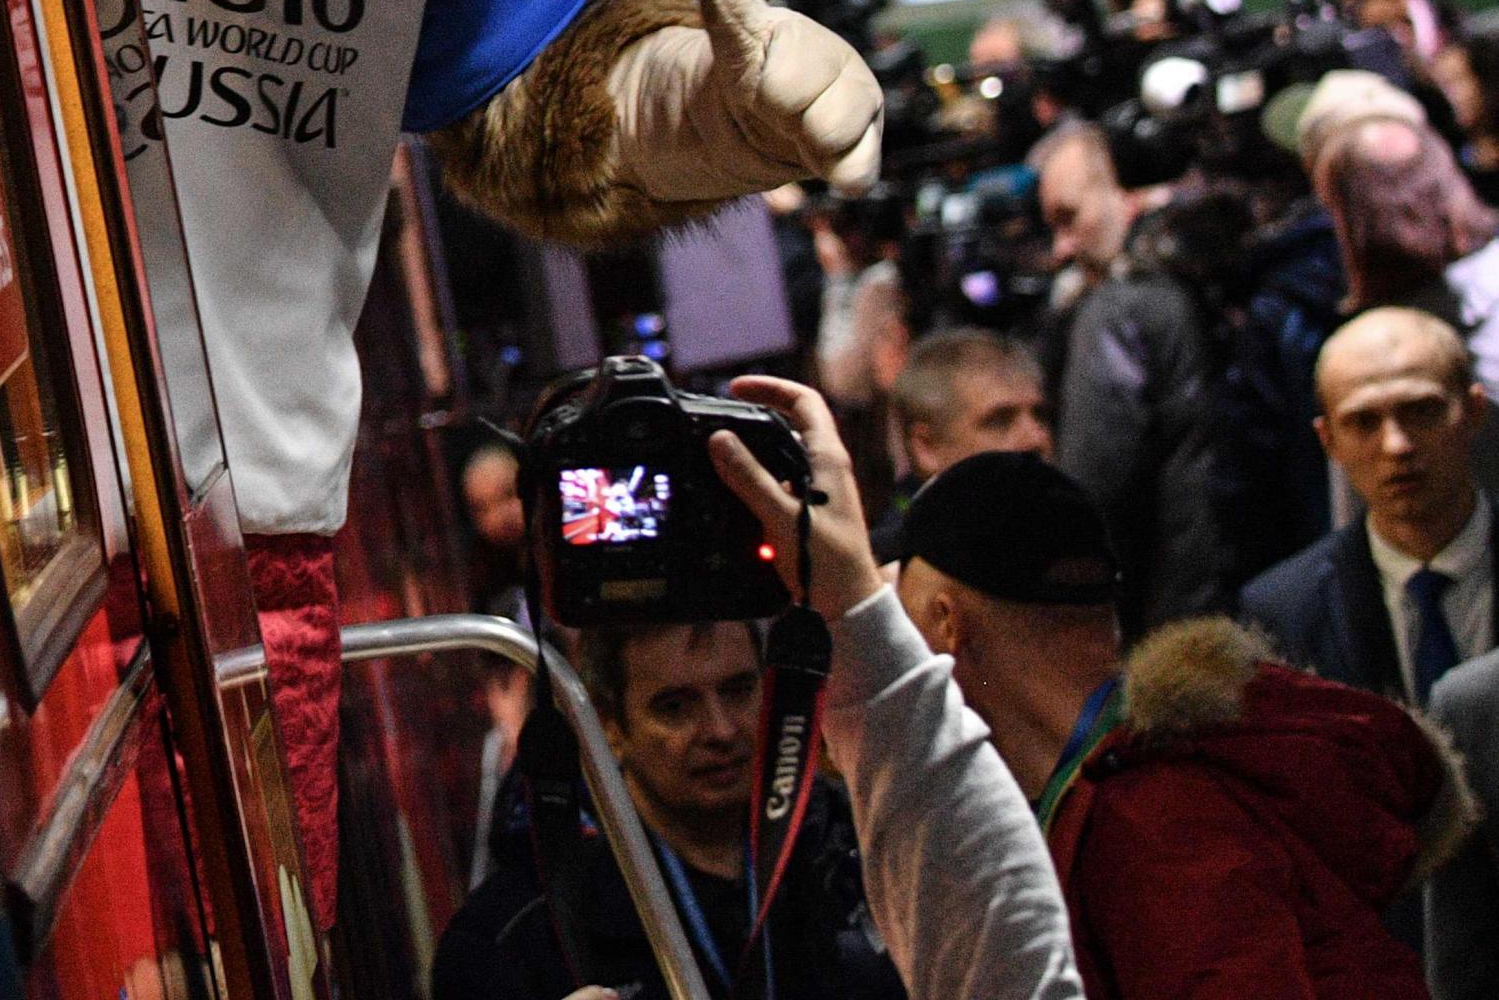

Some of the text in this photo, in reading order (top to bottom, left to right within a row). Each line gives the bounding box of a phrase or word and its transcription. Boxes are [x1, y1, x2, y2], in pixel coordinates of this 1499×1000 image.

[186, 16, 303, 67] WORLD
[306, 42, 359, 76] CUP
[766, 715, 806, 821] Canon
